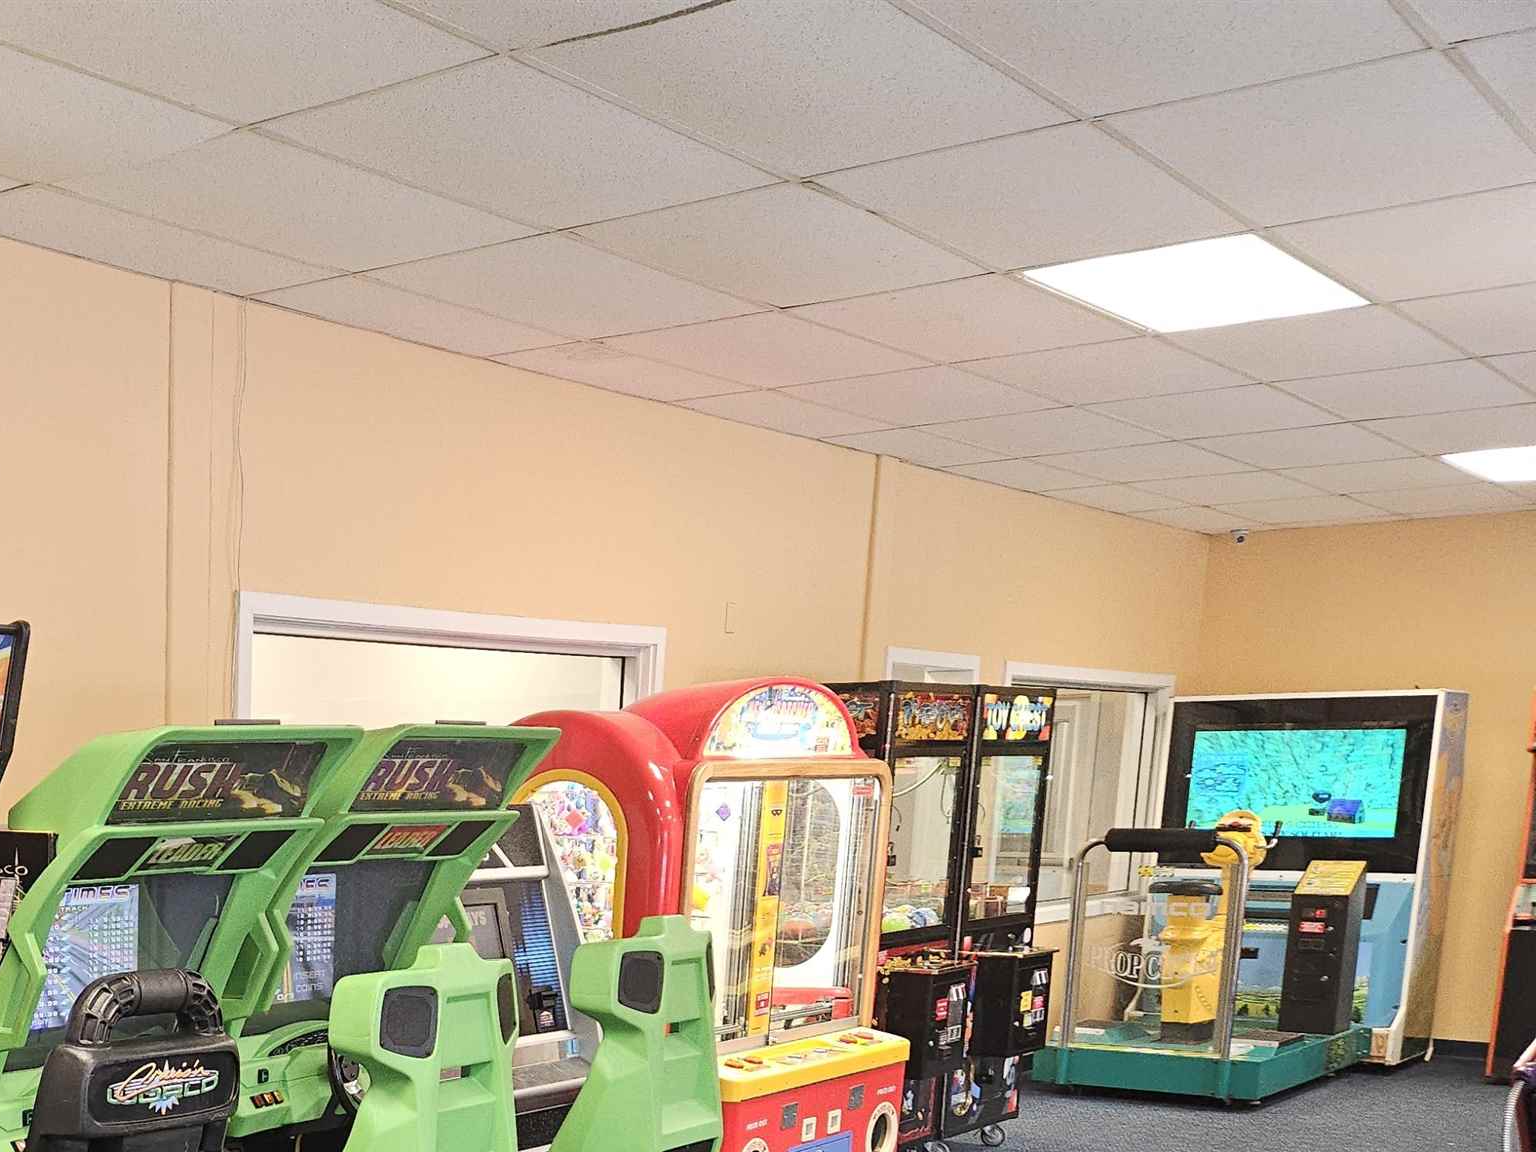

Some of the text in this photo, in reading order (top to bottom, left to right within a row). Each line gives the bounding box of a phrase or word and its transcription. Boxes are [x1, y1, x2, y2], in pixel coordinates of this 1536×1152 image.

[987, 700, 1009, 730] TOY
[120, 763, 240, 801] RUSH
[365, 759, 454, 792] RUSH
[120, 799, 224, 811] EXTREME RACING
[147, 842, 225, 864] LEADER
[372, 831, 439, 849] LEADER
[117, 1059, 210, 1101] Cruis'n
